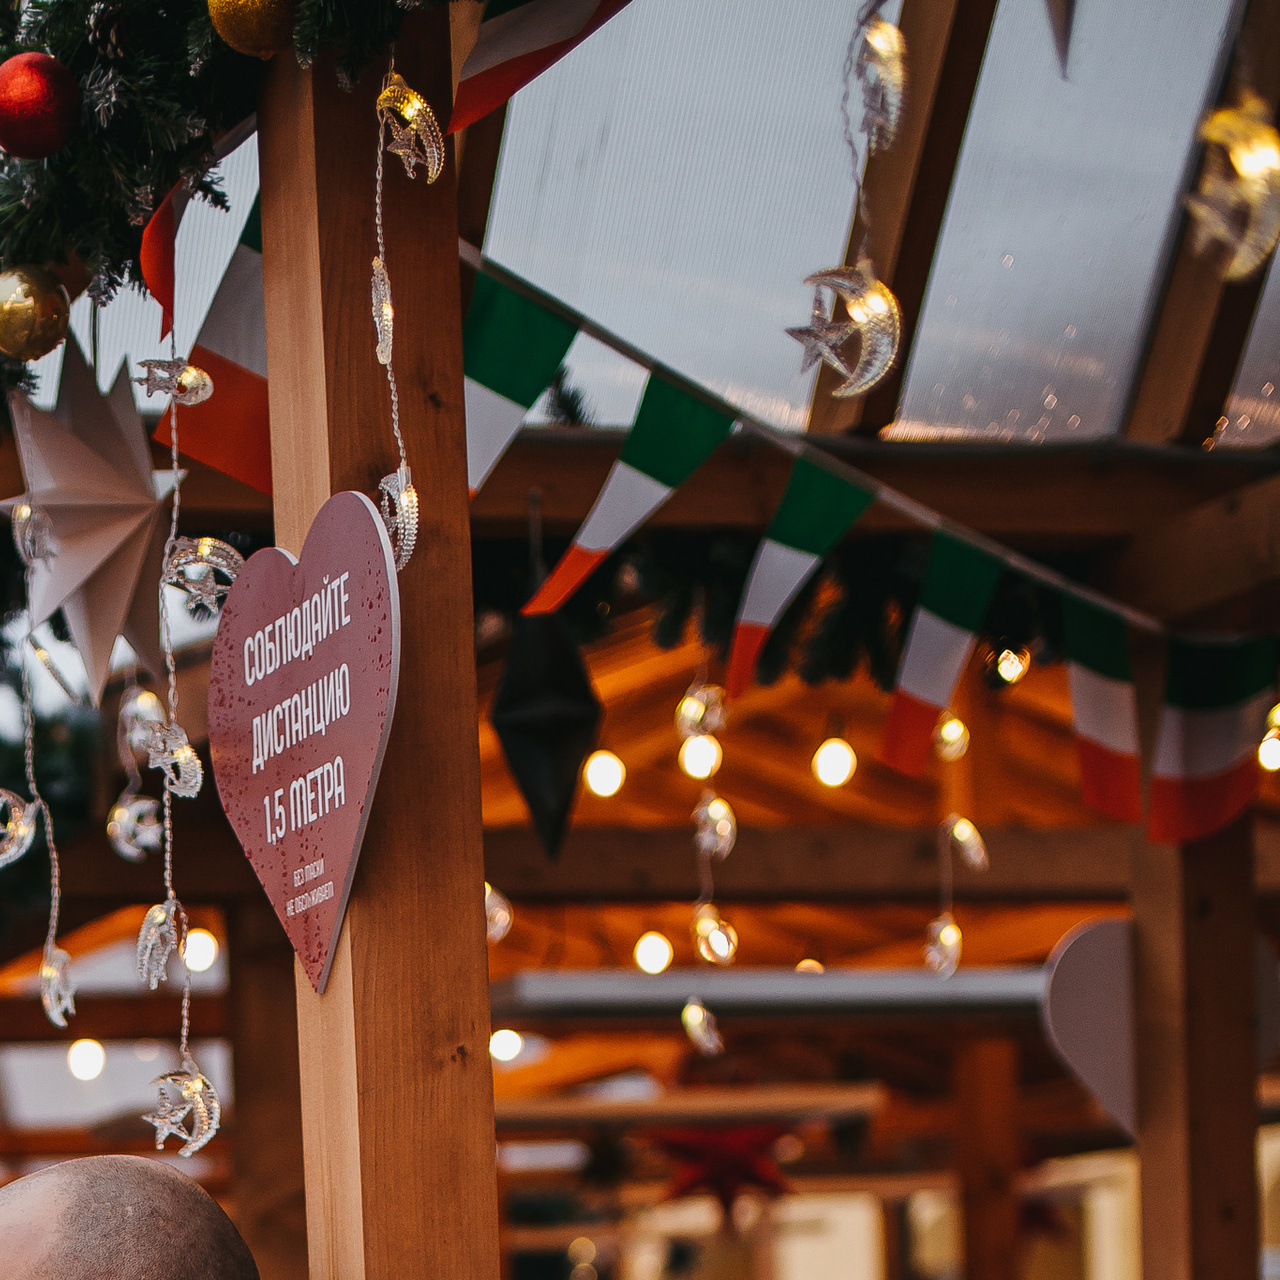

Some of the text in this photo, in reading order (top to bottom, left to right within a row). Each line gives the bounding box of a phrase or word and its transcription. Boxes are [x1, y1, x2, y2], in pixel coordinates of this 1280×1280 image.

[243, 571, 351, 686] СОБЛЮДАЙТЕ
[252, 662, 351, 774] ДИСТАНЦИЮ
[263, 755, 346, 846] 1,5 МЕТРА
